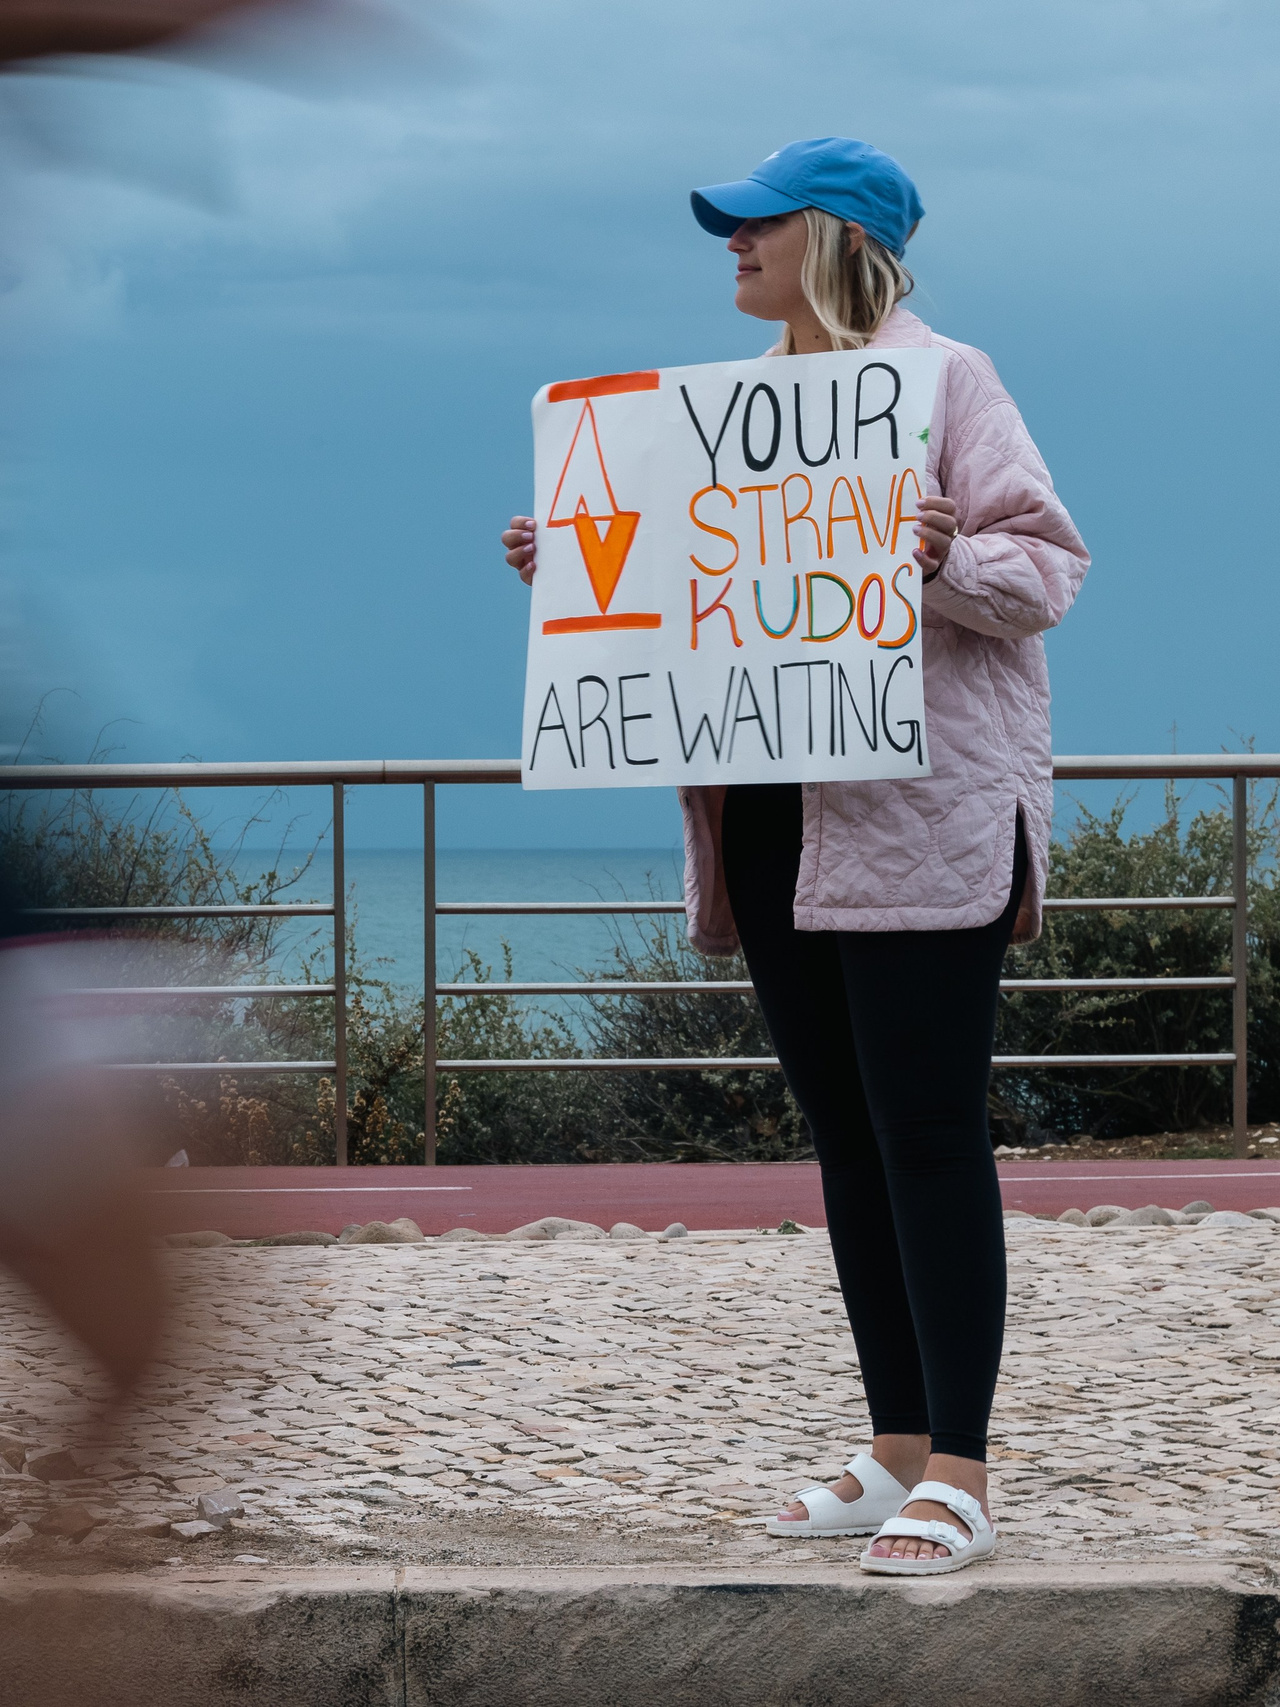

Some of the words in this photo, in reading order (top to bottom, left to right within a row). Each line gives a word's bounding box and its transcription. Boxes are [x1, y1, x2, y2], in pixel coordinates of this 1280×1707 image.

[680, 362, 901, 488] YOUR
[689, 468, 925, 576] STRAVA
[690, 562, 917, 650] KUDOS
[529, 672, 659, 770] ARE
[668, 655, 923, 765] WAITING
